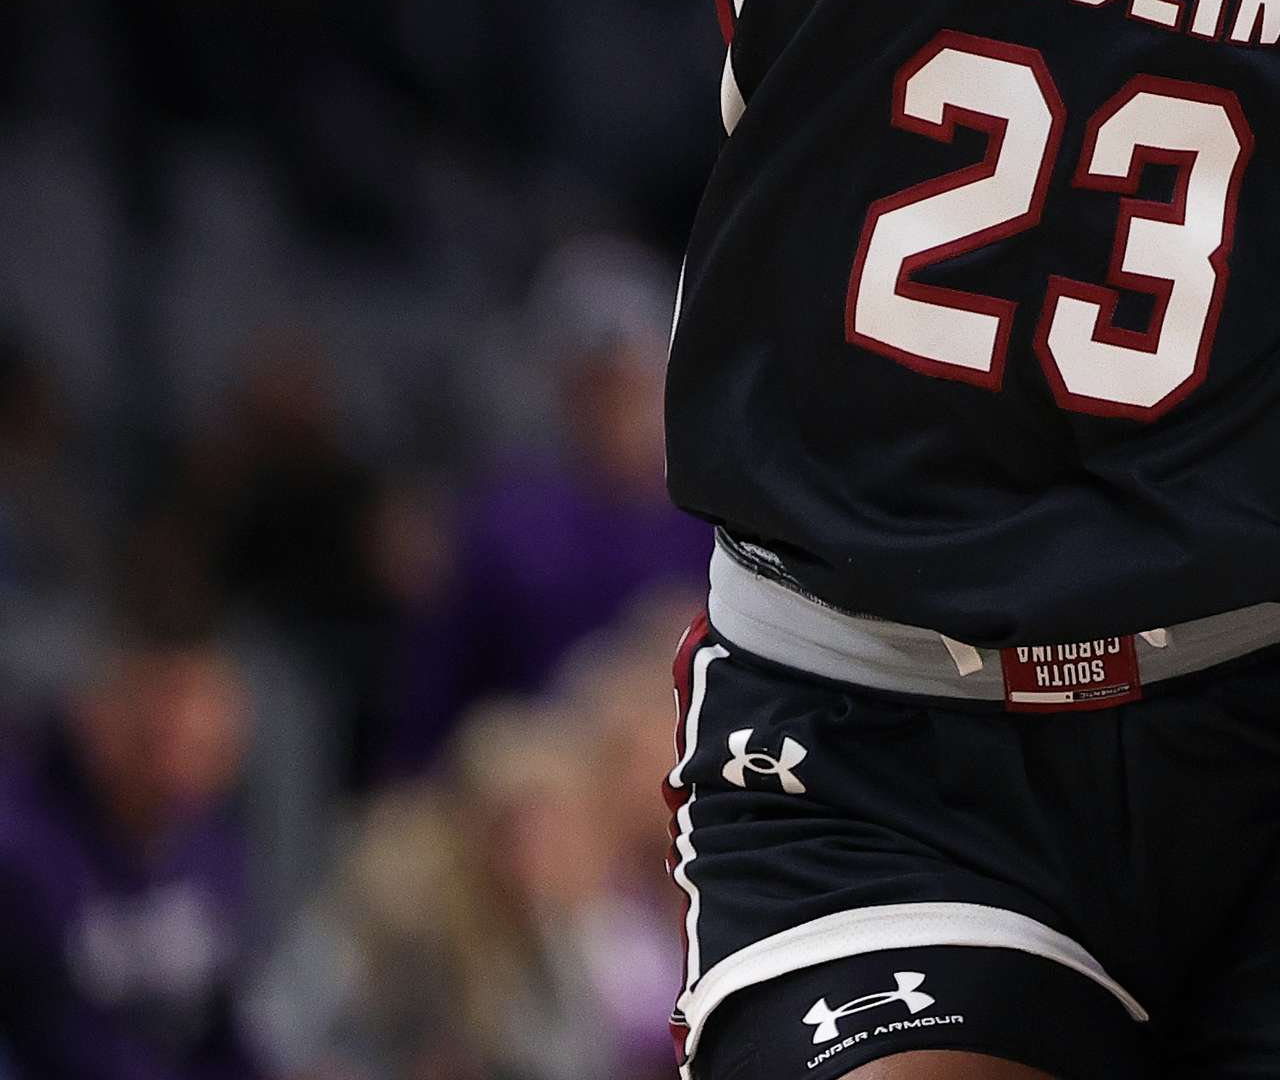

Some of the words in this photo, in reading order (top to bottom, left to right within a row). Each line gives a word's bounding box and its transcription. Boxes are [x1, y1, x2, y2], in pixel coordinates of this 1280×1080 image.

[845, 28, 1255, 423] 23
[1036, 659, 1106, 687] SOUTH
[807, 1031, 869, 1069] UNDER
[873, 1015, 964, 1036] ARMOUR
